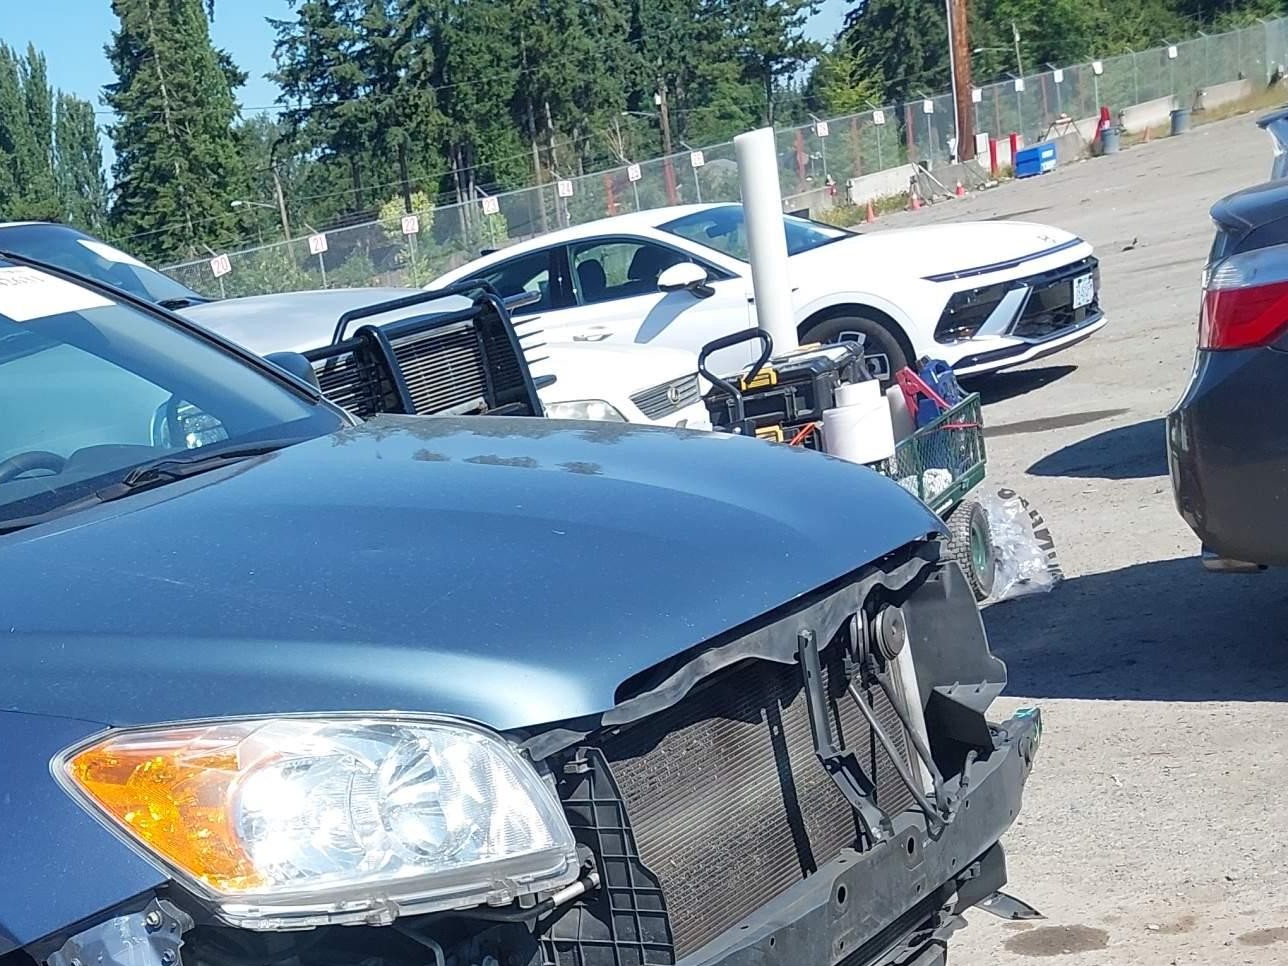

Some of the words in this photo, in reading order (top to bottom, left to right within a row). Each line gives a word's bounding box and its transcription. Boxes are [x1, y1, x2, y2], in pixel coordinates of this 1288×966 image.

[404, 217, 416, 232] 22
[313, 237, 325, 252] 21
[214, 256, 229, 274] 20
